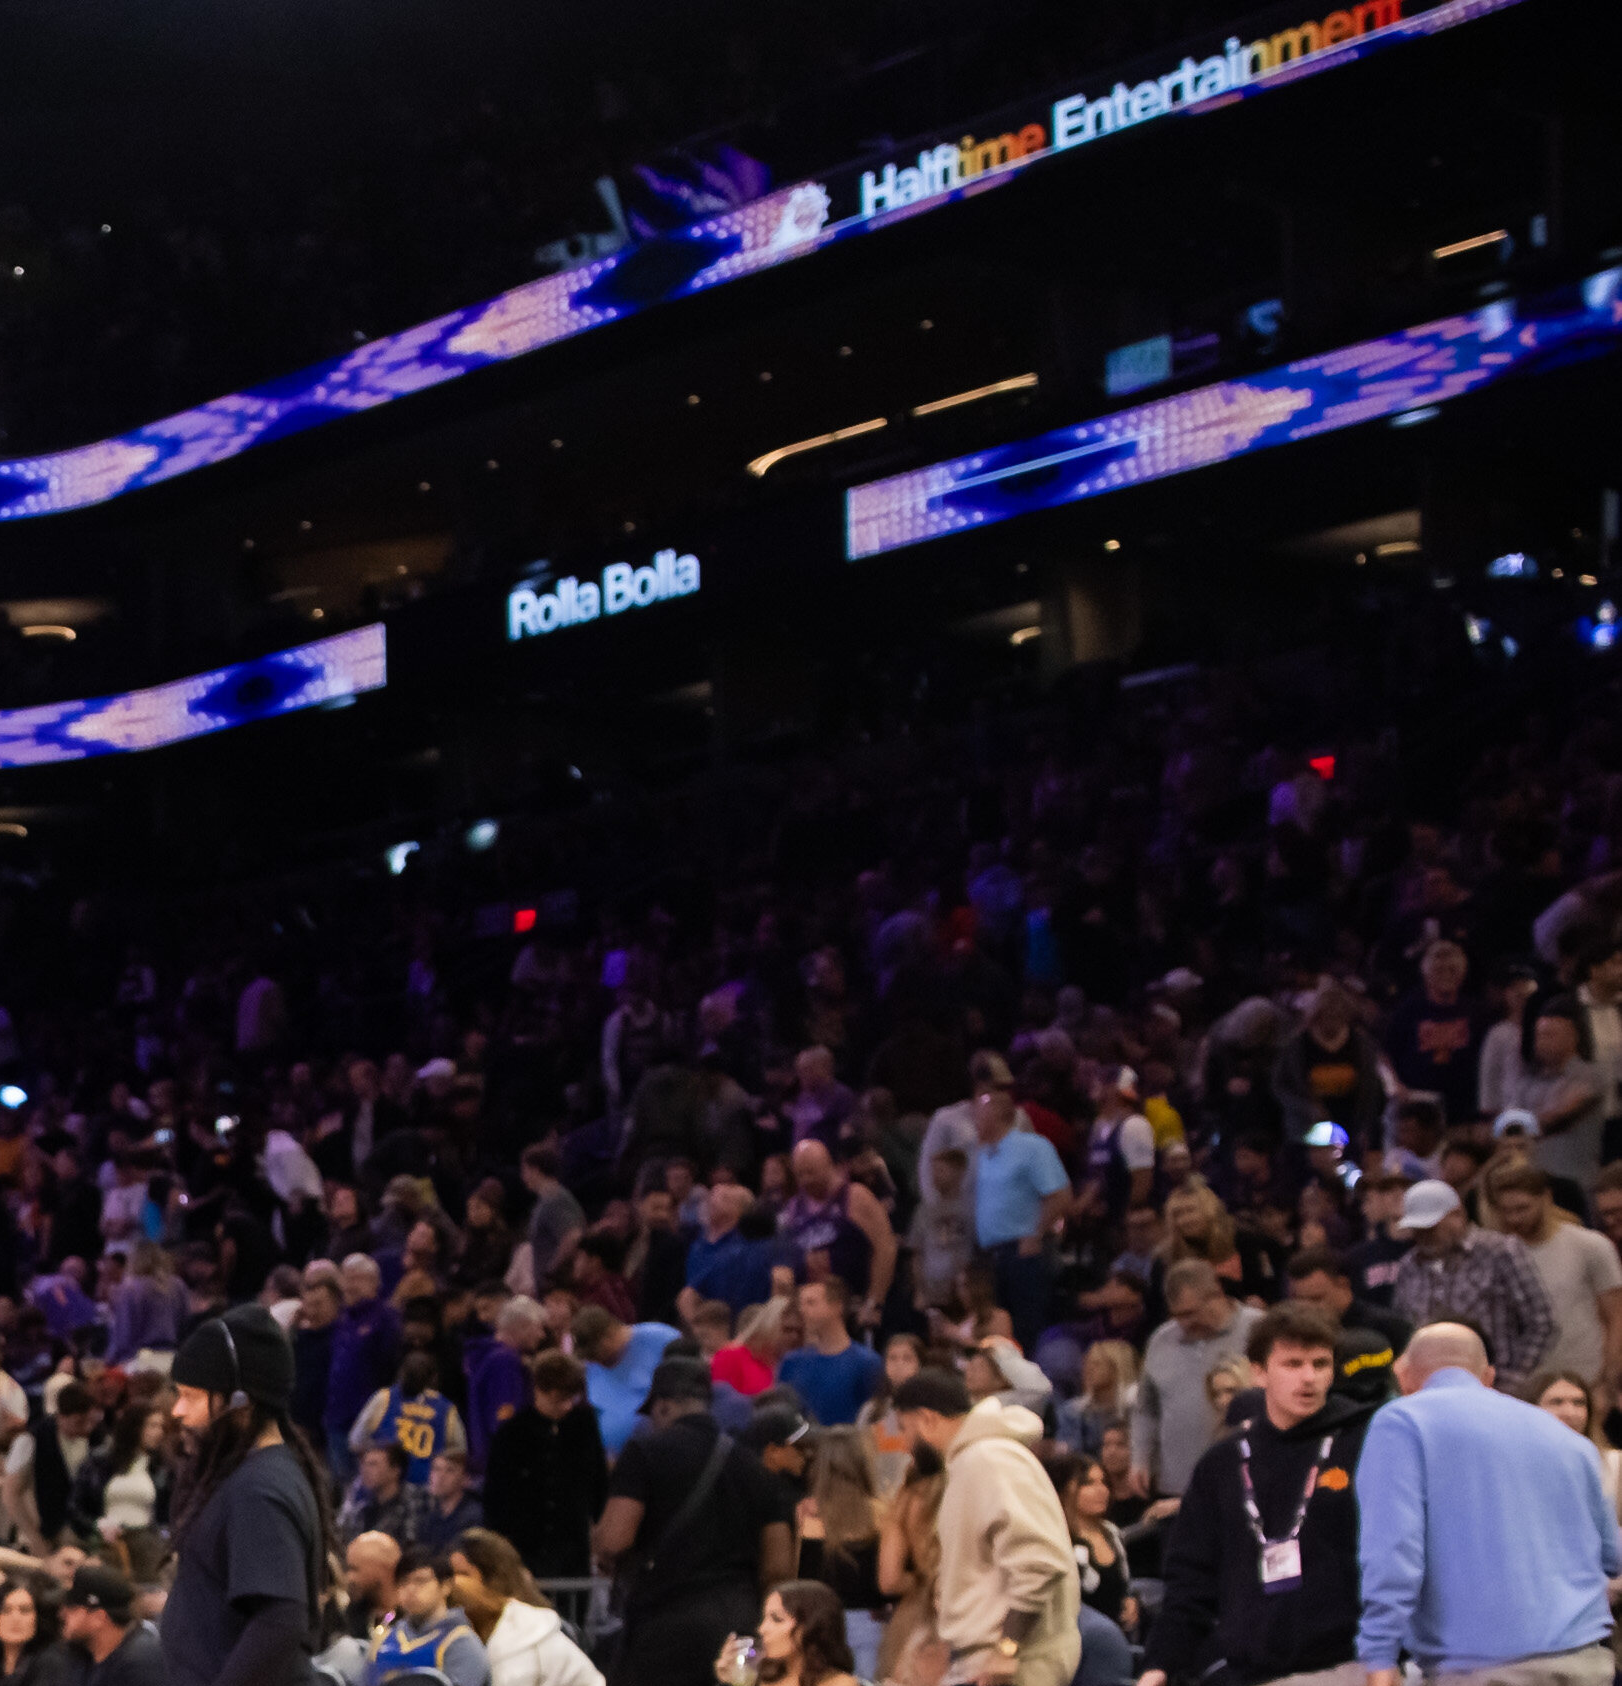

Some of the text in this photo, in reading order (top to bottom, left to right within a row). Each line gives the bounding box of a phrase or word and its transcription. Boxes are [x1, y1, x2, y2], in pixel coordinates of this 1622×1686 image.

[861, 122, 1046, 219] Halftime
[508, 547, 701, 642] Rolla Bolla
